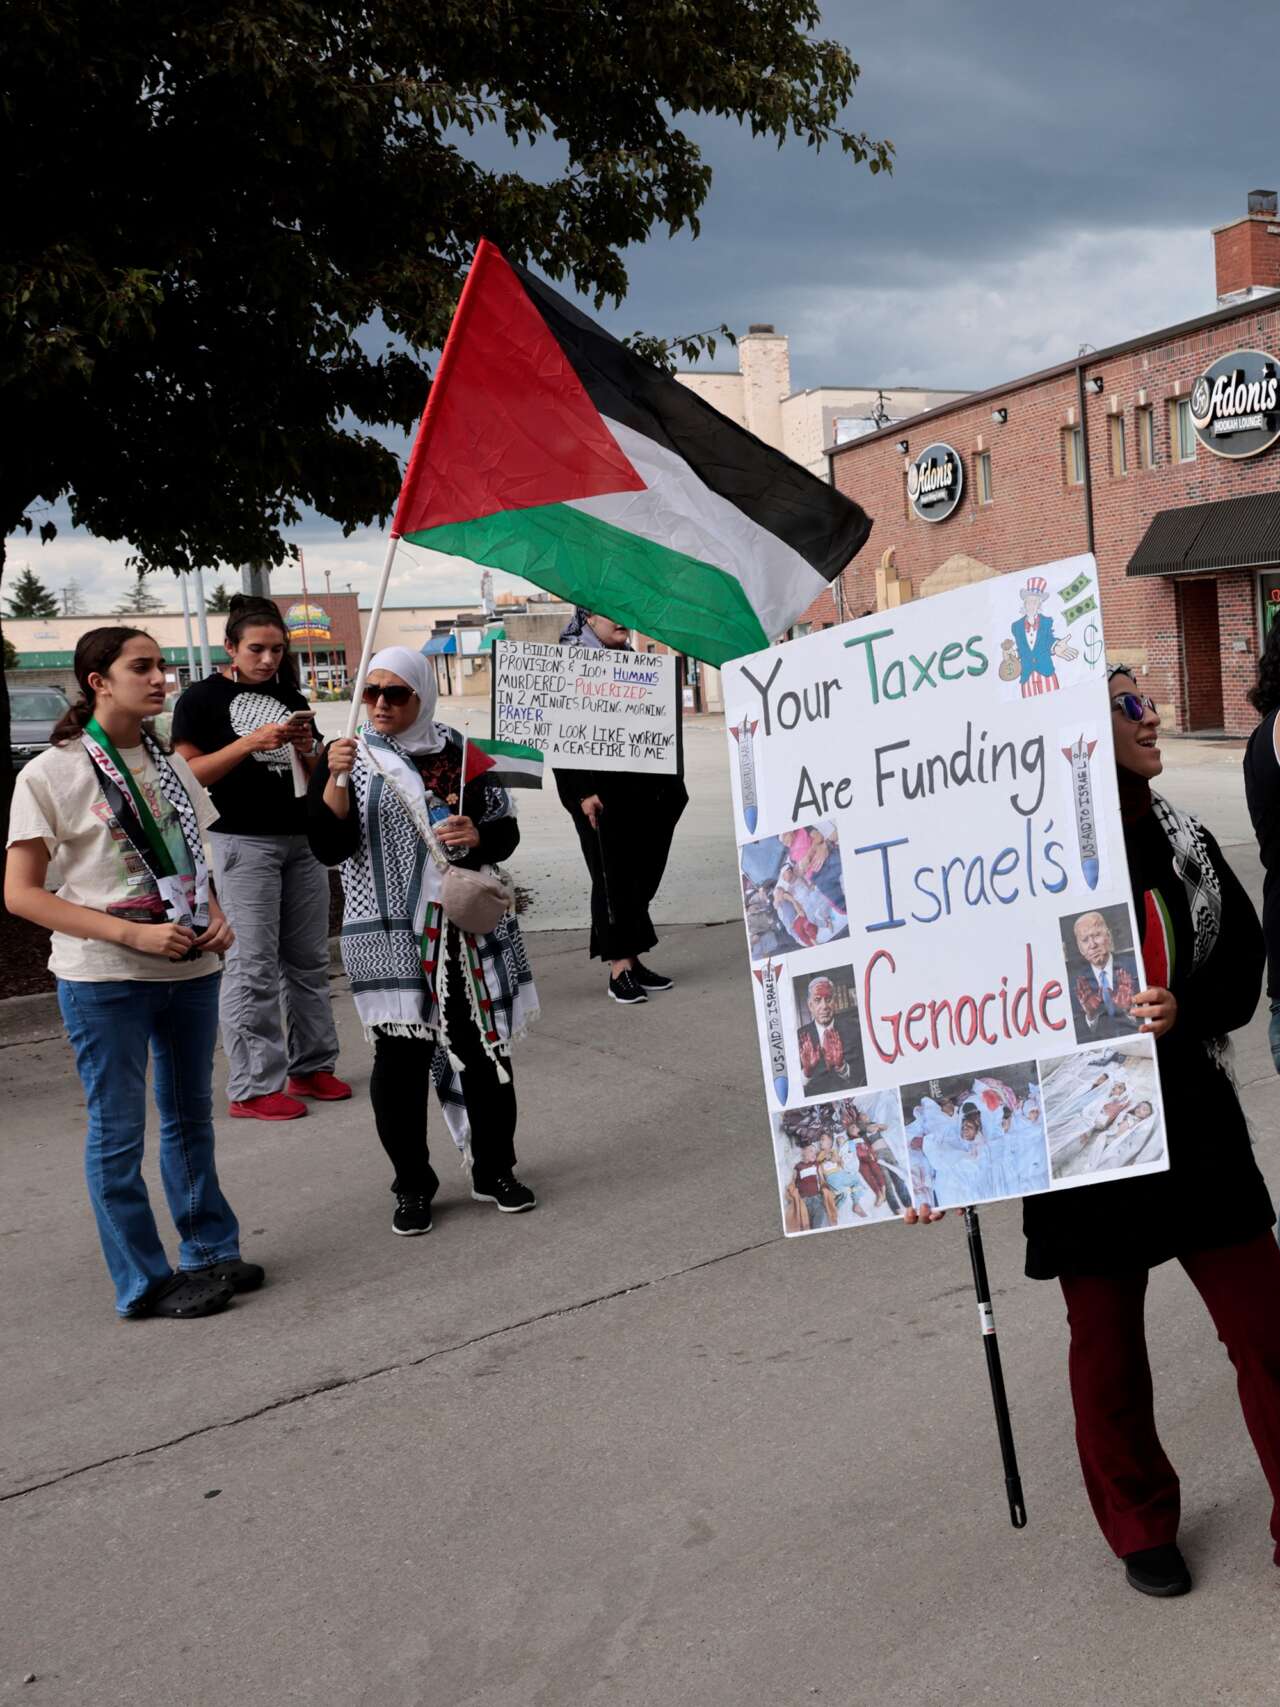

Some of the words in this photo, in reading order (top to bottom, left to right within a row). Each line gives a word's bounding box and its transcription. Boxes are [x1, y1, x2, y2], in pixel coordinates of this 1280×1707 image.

[1205, 364, 1278, 420] Adonis
[1215, 419, 1239, 432] HOOKAH
[1240, 415, 1263, 428] LOUNGE
[915, 456, 953, 494] Adonis
[499, 641, 517, 653] 35
[523, 643, 562, 657] BILLION
[569, 646, 611, 661] DOLLARS
[614, 652, 629, 664] IN
[634, 655, 663, 667] ARMS
[499, 654, 565, 674] PROVISIONS
[613, 667, 660, 684] HUMANS
[740, 658, 842, 736] Your
[845, 629, 989, 704] Taxes
[497, 690, 513, 704] IN
[518, 690, 526, 705] 2
[530, 693, 579, 709] MINUTES
[582, 697, 621, 712] DURING
[625, 703, 666, 716] MORNING
[498, 705, 544, 721] PRAYER
[497, 734, 549, 750] TARDS
[553, 743, 560, 752] A
[562, 740, 625, 757] CEASEFIRE
[628, 744, 640, 757] TO
[499, 720, 531, 735] DOES
[534, 723, 552, 736] NOT
[559, 724, 587, 740] LOOK
[593, 725, 625, 743] LIKE
[629, 730, 674, 746] WORKING
[792, 765, 853, 822] Are
[874, 721, 1045, 816] Funding
[1077, 761, 1089, 807] ISRAEL
[855, 817, 1068, 932] Israel's
[766, 973, 778, 1016] ISRAEL
[865, 943, 1067, 1064] Genocide
